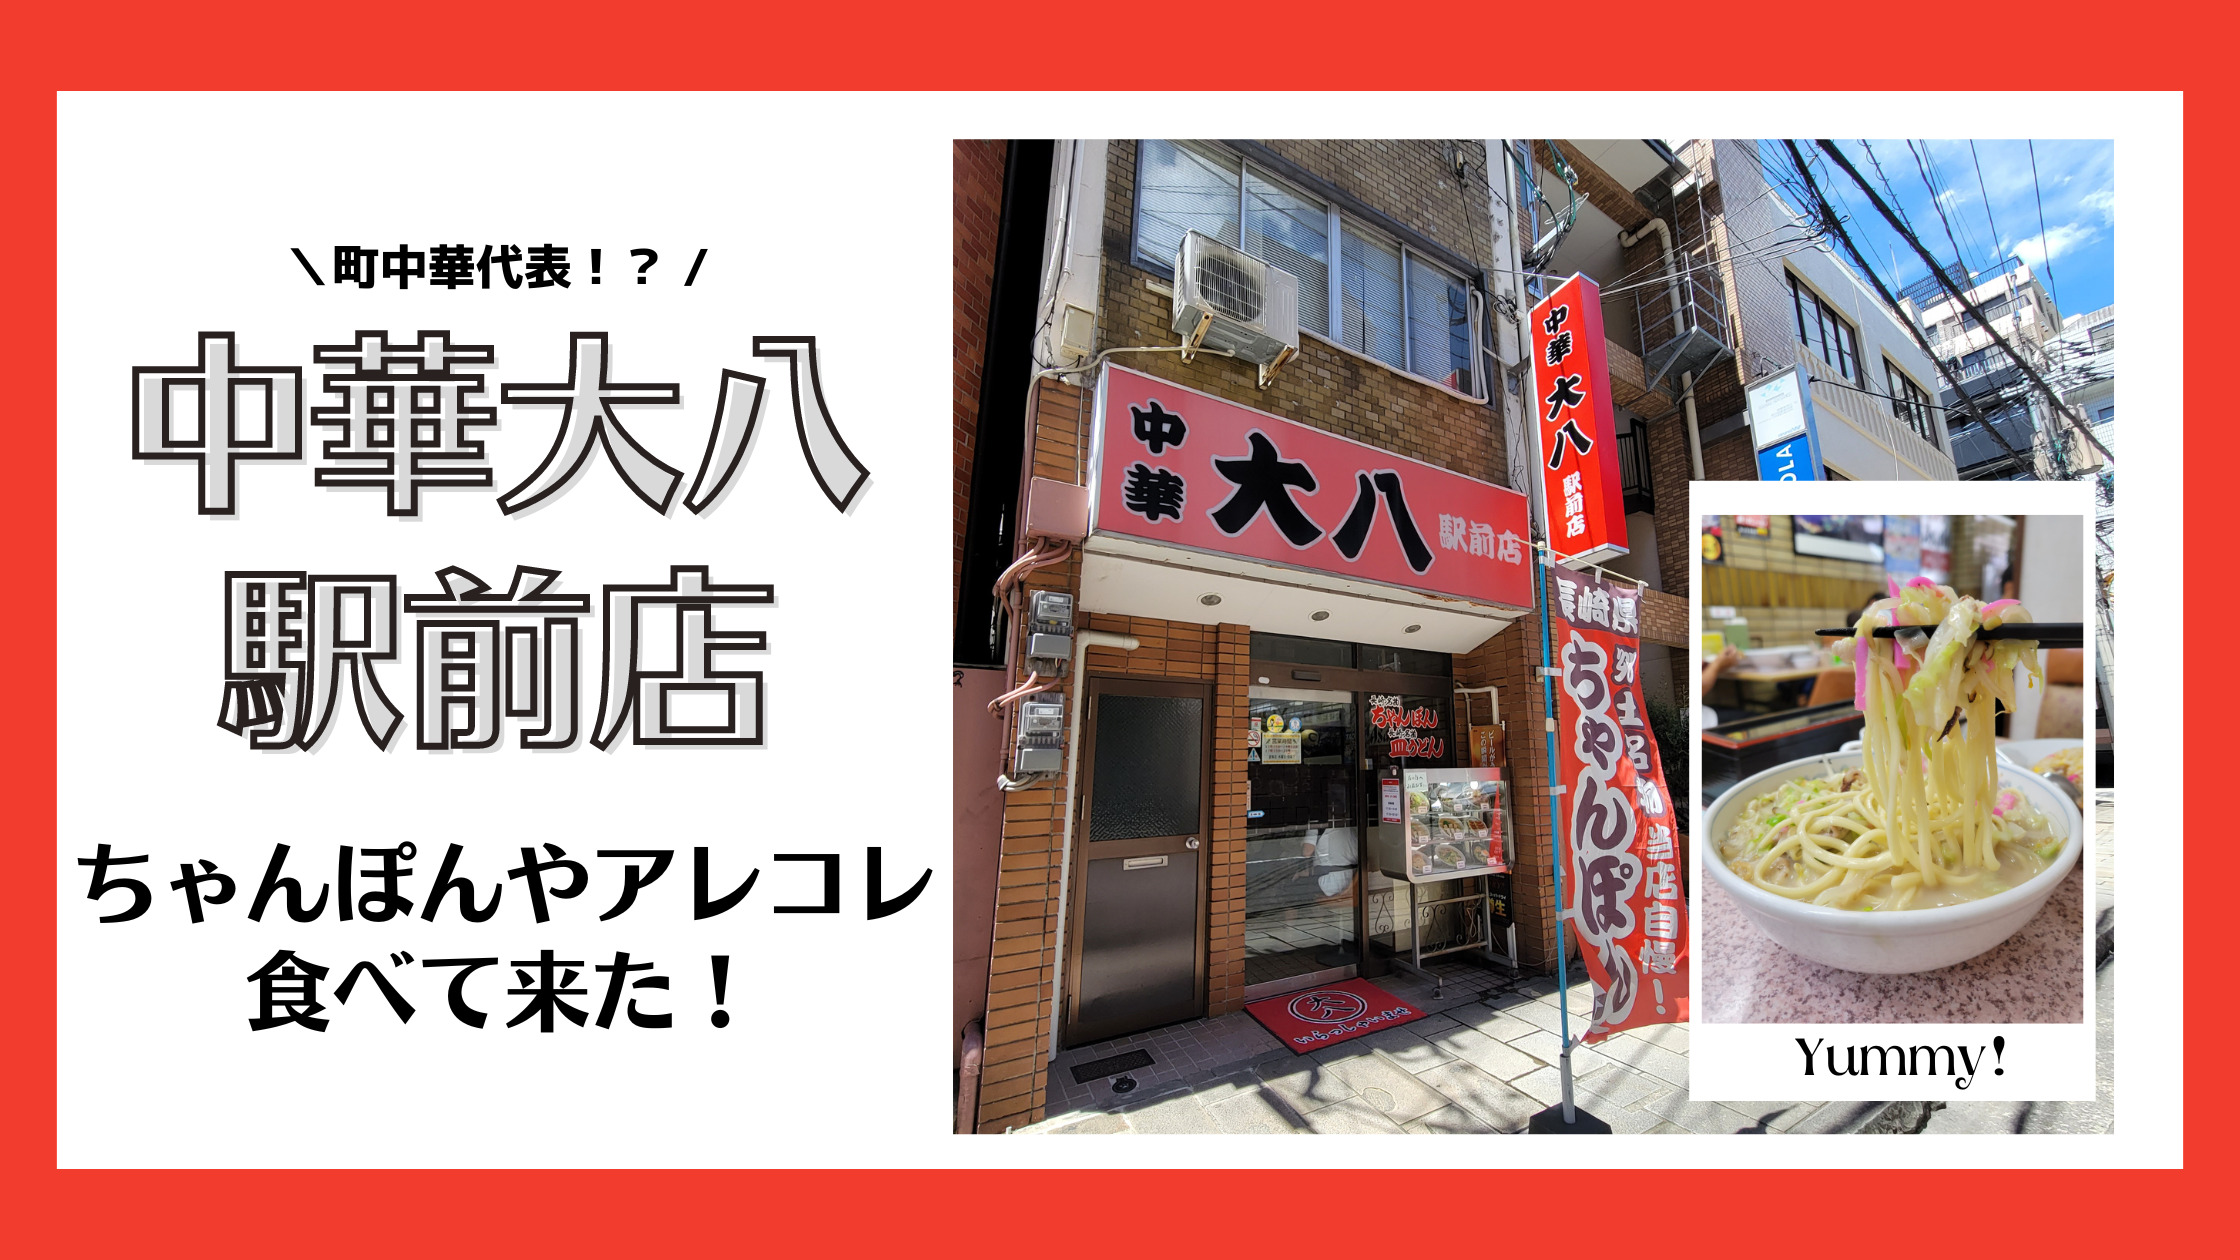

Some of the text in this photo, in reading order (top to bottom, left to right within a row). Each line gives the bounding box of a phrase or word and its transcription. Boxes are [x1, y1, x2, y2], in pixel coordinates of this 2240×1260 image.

[1543, 304, 1572, 366] 中華
[1546, 374, 1593, 470] 大八
[1124, 399, 1523, 575] 中華 大八 駅前店
[1562, 470, 1587, 538] 駅前店
[1555, 576, 1638, 634] 長崎県
[1389, 736, 1444, 759] 皿うどん
[1564, 636, 1637, 1018] ちゃんぽん
[1293, 1006, 1413, 1045] いらっしゃいませ
